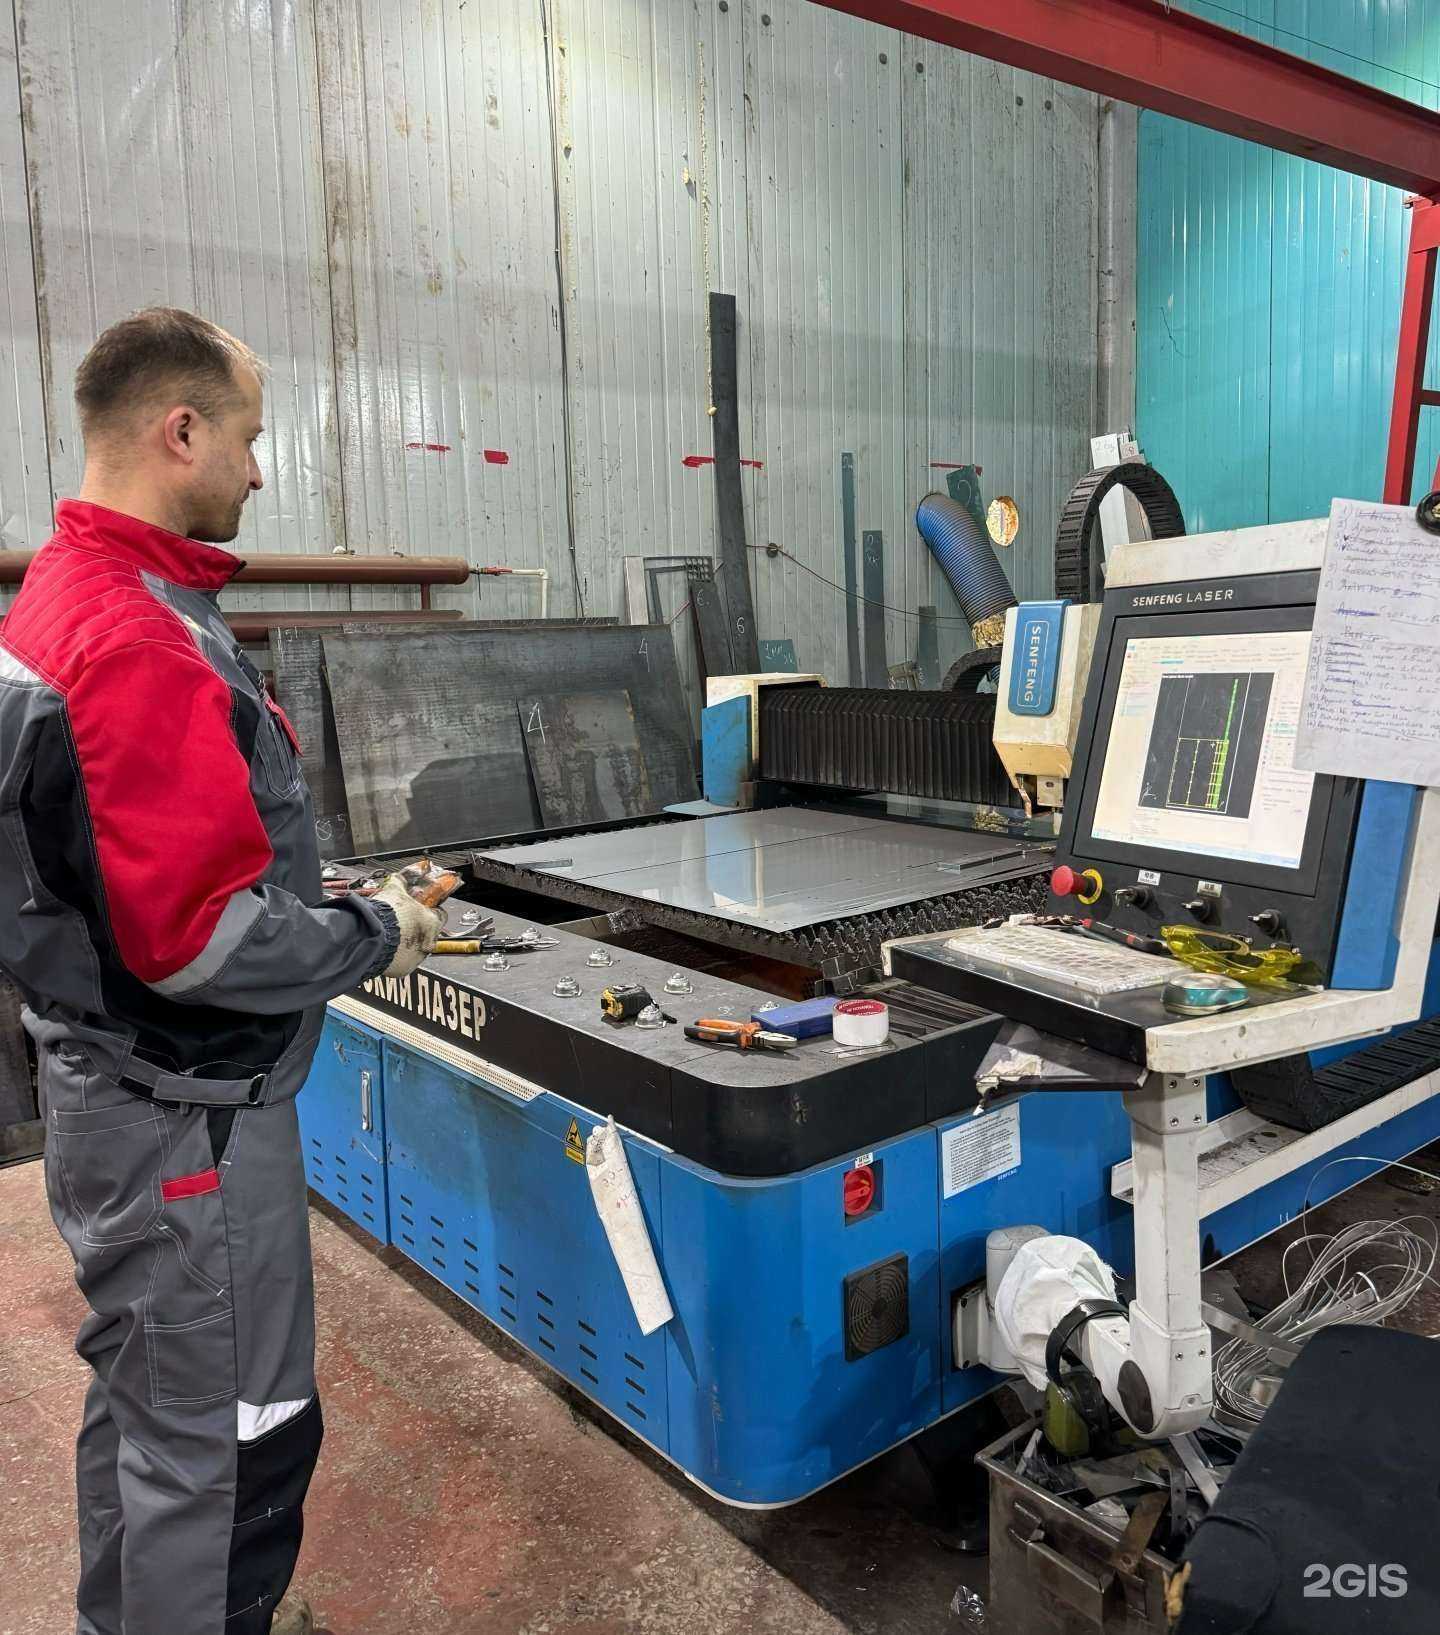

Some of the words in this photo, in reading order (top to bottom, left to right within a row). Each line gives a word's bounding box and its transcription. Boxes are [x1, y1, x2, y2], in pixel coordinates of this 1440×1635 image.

[1132, 593, 1183, 607] SENFENG
[1186, 589, 1234, 603] LASER
[1024, 625, 1042, 702] SENFENG
[527, 702, 551, 745] 4
[417, 973, 487, 1042] ЛАЗЕР
